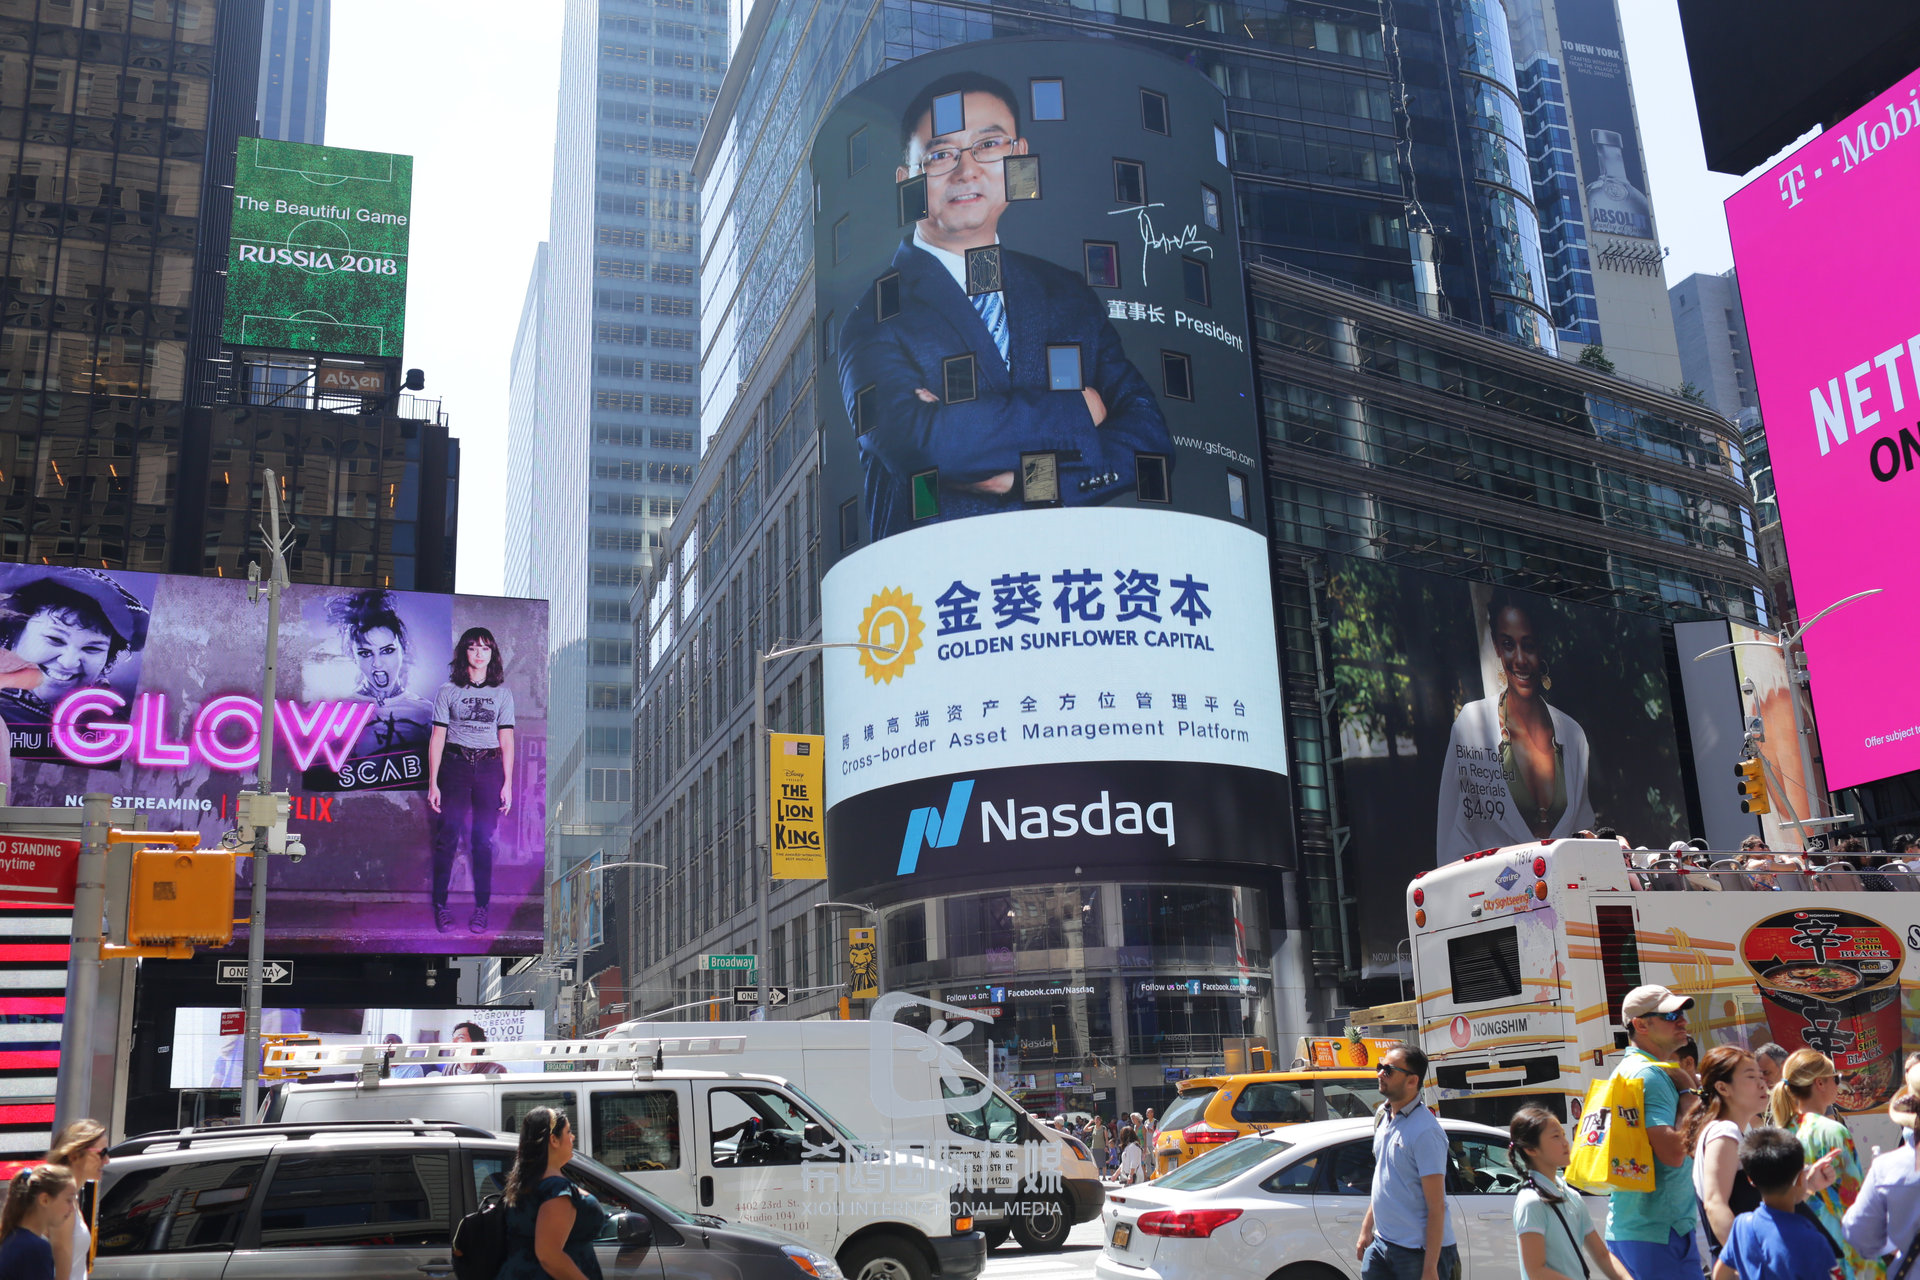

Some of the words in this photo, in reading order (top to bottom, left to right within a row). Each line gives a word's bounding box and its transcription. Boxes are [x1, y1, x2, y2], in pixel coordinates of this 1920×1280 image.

[1562, 40, 1574, 50] TO
[1575, 43, 1594, 54] NEW
[235, 195, 270, 212] The
[275, 199, 350, 221] Beautiful
[356, 208, 408, 226] Game
[238, 244, 335, 270] RUSSIA
[340, 255, 398, 276] 2018
[1107, 299, 1166, 325] 董事长
[1174, 310, 1244, 353] President
[324, 371, 381, 390] Absen
[1172, 434, 1256, 469] www.gsfcap.com
[934, 568, 1213, 637] 金葵花资本
[936, 635, 1014, 661] GOLDEN
[1020, 629, 1139, 651] SUNFLOWER
[1143, 630, 1215, 652] CAPITAL
[52, 687, 376, 774] GLOW
[1864, 735, 1885, 748] Offer
[1885, 726, 1915, 743] subject
[842, 738, 936, 776] Cross-border
[949, 726, 1007, 749] Asset
[1022, 720, 1165, 740] Management
[1178, 720, 1249, 743] Platform
[1456, 744, 1484, 760] Bikini
[1485, 748, 1505, 766] Top
[338, 755, 422, 788] SCAB
[784, 768, 805, 778] Disney
[1457, 762, 1468, 776] in
[1470, 763, 1516, 782] Recycled
[781, 783, 808, 798] THE
[1460, 780, 1506, 798] Materials
[111, 797, 213, 812] STREAMING
[777, 799, 814, 822] LION
[1463, 796, 1506, 820] $4.99
[980, 790, 1176, 847] Nasdaq
[775, 823, 821, 850] KING
[11, 842, 62, 857] STANDING
[1514, 849, 1533, 867] 71512
[1483, 899, 1494, 911] City
[1495, 893, 1529, 909] Sightseeing
[1790, 919, 1853, 965] 辛
[711, 956, 753, 969] Broadway
[1372, 953, 1390, 961] NOW
[1391, 953, 1399, 961] IN
[1839, 950, 1891, 958] BLACK
[741, 992, 758, 1000] ONE
[946, 993, 968, 1003] Follow
[968, 993, 977, 1001] us
[978, 992, 989, 1000] on:
[1008, 985, 1095, 998] Facebook.com/Nasdaq
[1141, 983, 1166, 992] Follow
[484, 1010, 511, 1019] GROW
[513, 1009, 526, 1018] UP
[489, 1017, 525, 1027] BECOME
[500, 1025, 524, 1036] YOU
[1472, 1018, 1528, 1037] NONGSHIM
[1020, 1037, 1059, 1049] Nasdaq
[1858, 1037, 1879, 1051] SHIN
[1846, 1045, 1884, 1066] BLACK
[991, 1177, 1010, 1185] 11220
[735, 1202, 758, 1212] 4402
[761, 1199, 782, 1210] 23rd
[787, 1199, 800, 1208] St.
[775, 1211, 796, 1220] 104)
